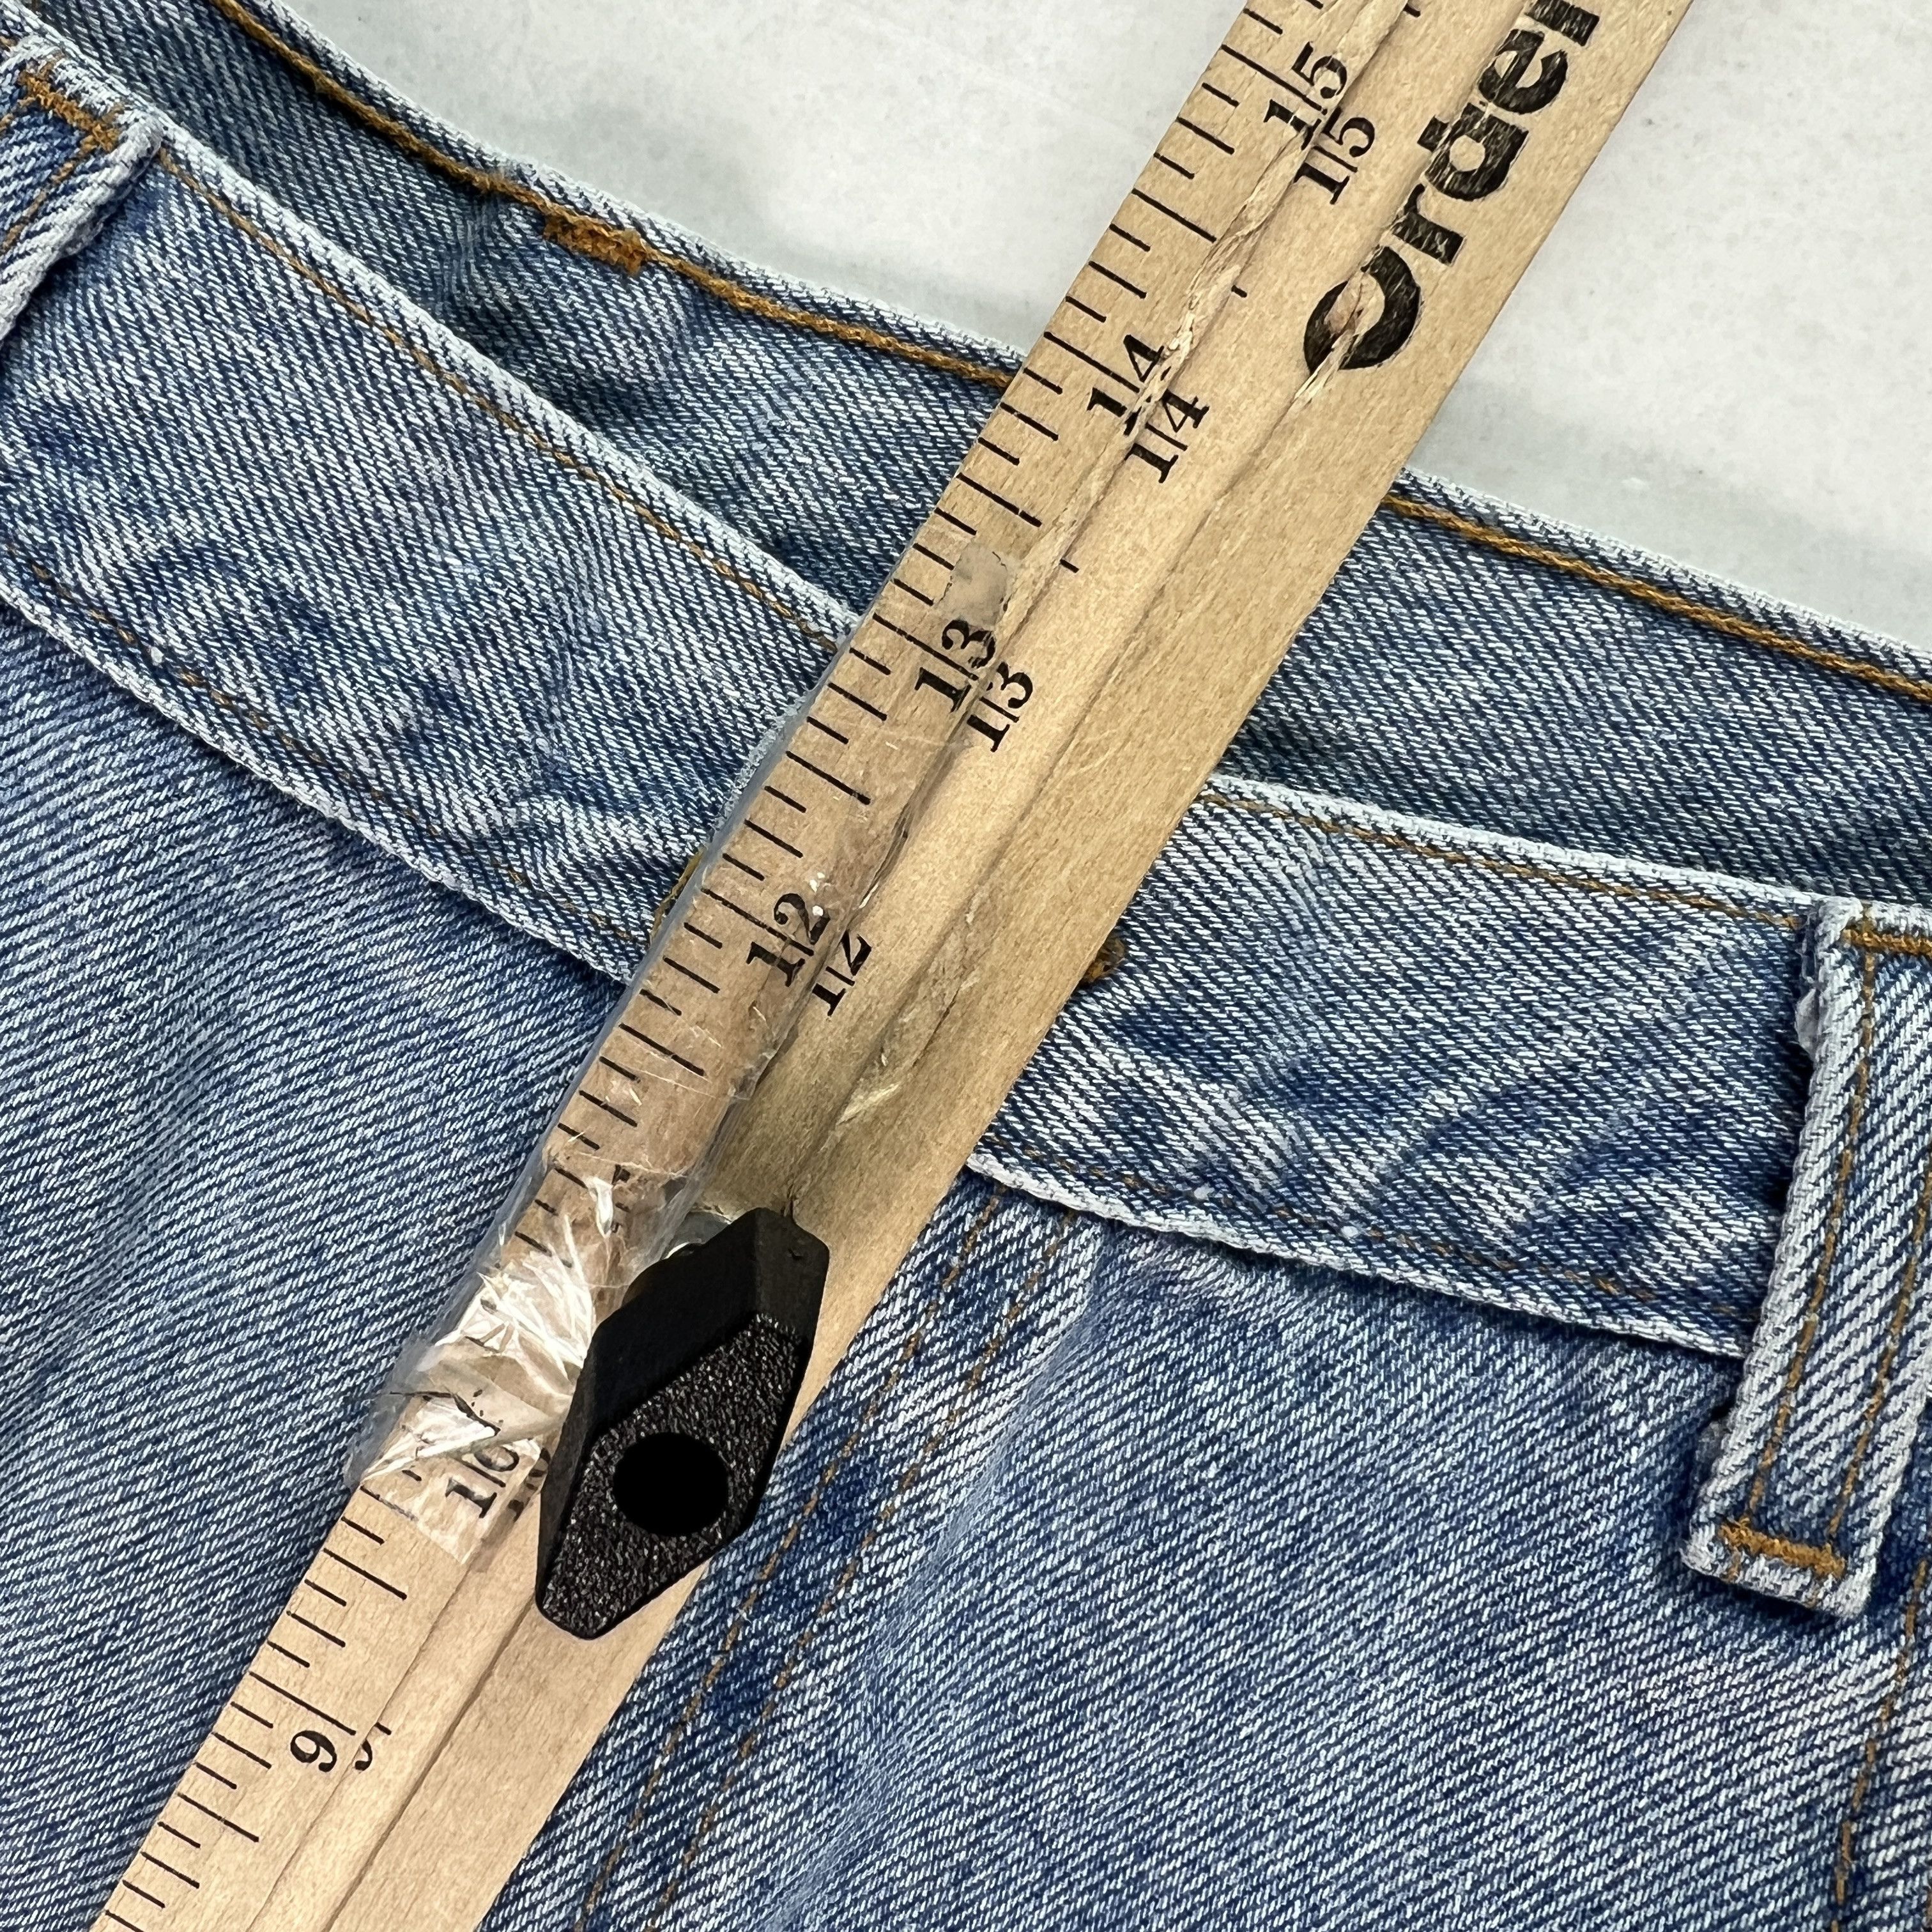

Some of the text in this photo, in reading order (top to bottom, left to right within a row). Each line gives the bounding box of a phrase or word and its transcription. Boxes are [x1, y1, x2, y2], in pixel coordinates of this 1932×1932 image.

[1264, 41, 1347, 151] 15
[1293, 106, 1376, 205] 15
[1087, 334, 1172, 436] 14
[1126, 389, 1210, 484] 14
[914, 618, 997, 713] 13
[967, 661, 1034, 753] 13
[746, 893, 831, 988] 12
[445, 1441, 520, 1519] 10
[289, 1729, 338, 1774] 9
